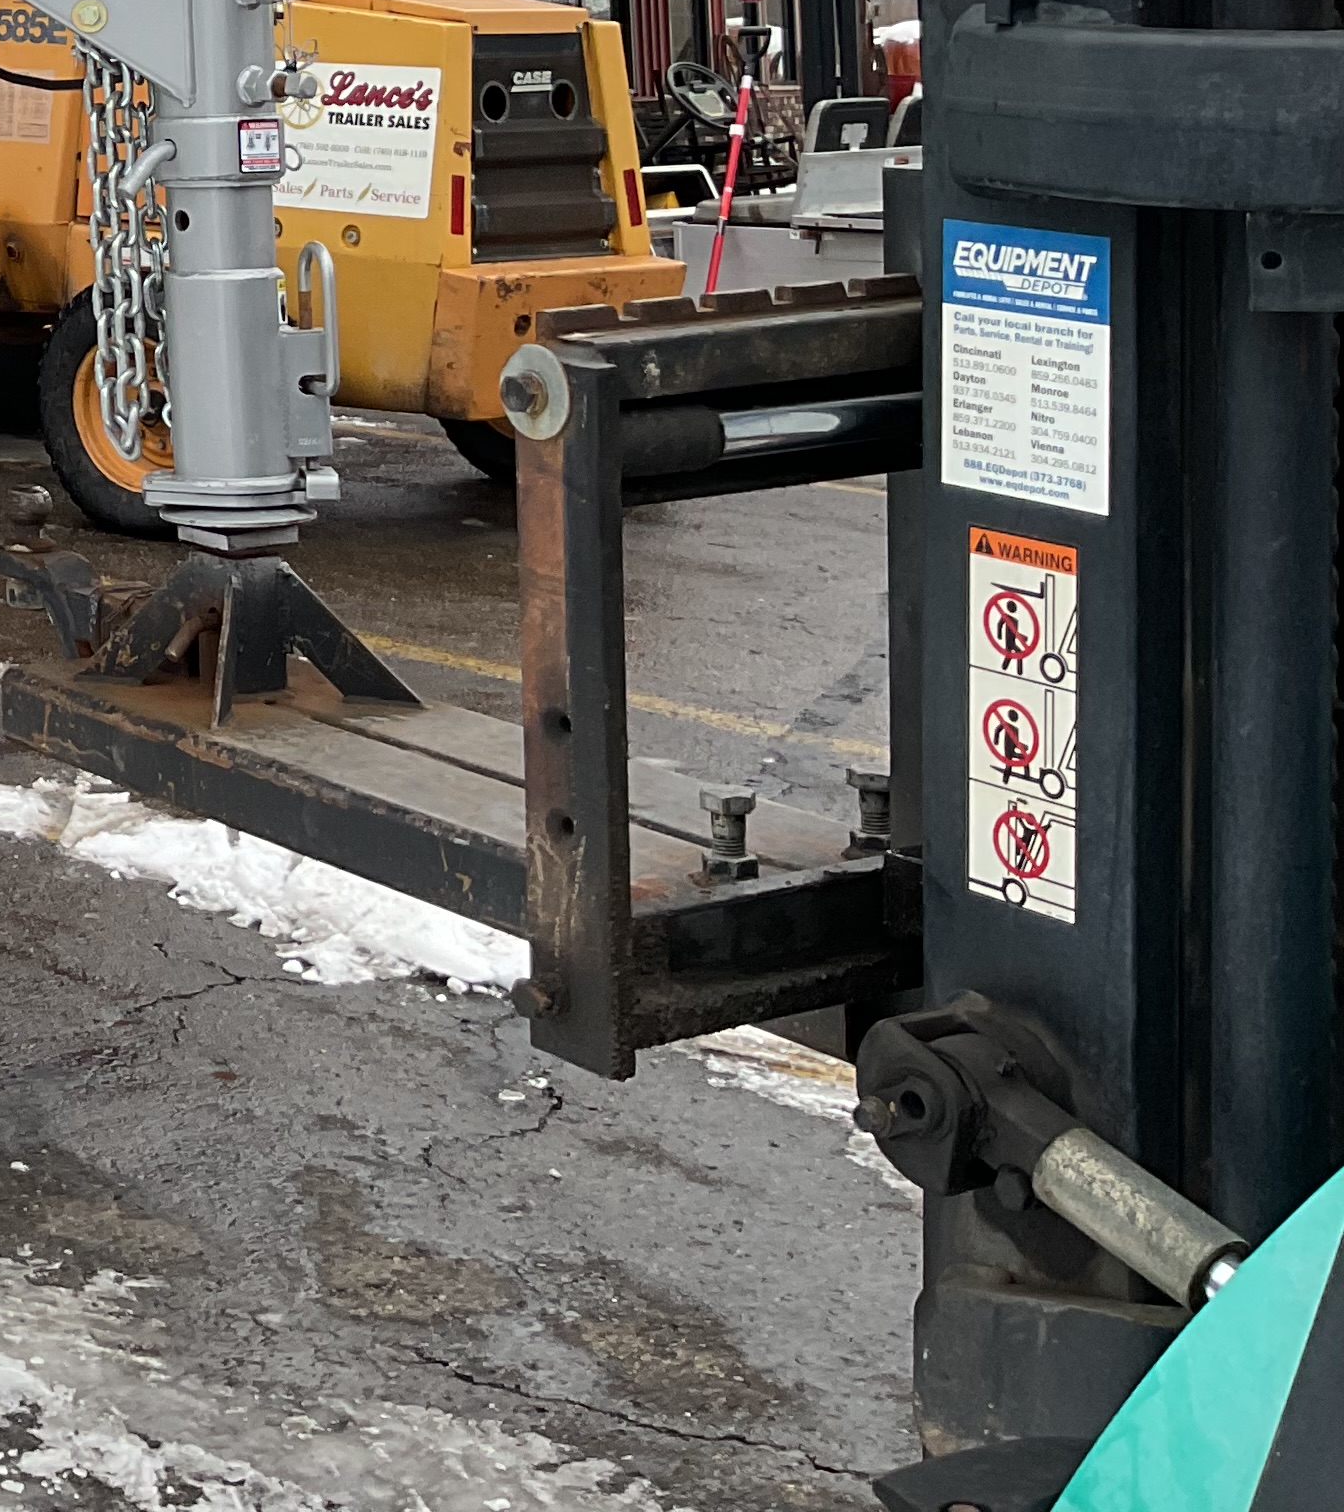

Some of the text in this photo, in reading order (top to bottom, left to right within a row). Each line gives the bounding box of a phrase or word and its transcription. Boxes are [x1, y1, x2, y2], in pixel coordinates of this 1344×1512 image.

[513, 71, 552, 85] CASE
[321, 70, 433, 111] Lance's
[328, 112, 430, 130] TRAILER SALES
[320, 184, 353, 199] Parts
[371, 188, 421, 204] Service
[953, 240, 1097, 282] EQUIPMENT
[1020, 278, 1070, 295] DEPOT
[954, 311, 1094, 340] Call your local branch for
[1014, 332, 1042, 346] Rental
[1045, 339, 1053, 347] or
[953, 343, 1001, 360] Cincinnati
[1031, 355, 1081, 372] Lexington
[953, 371, 986, 385] Dayton
[1031, 383, 1069, 398] Monroe
[953, 398, 993, 414] Erlanger
[1031, 411, 1055, 424] Nitro
[953, 425, 993, 441] Lebanon
[1030, 439, 1065, 454] Vienna
[979, 475, 1069, 500] www.eqdepot.com
[998, 541, 1072, 571] WARNING
